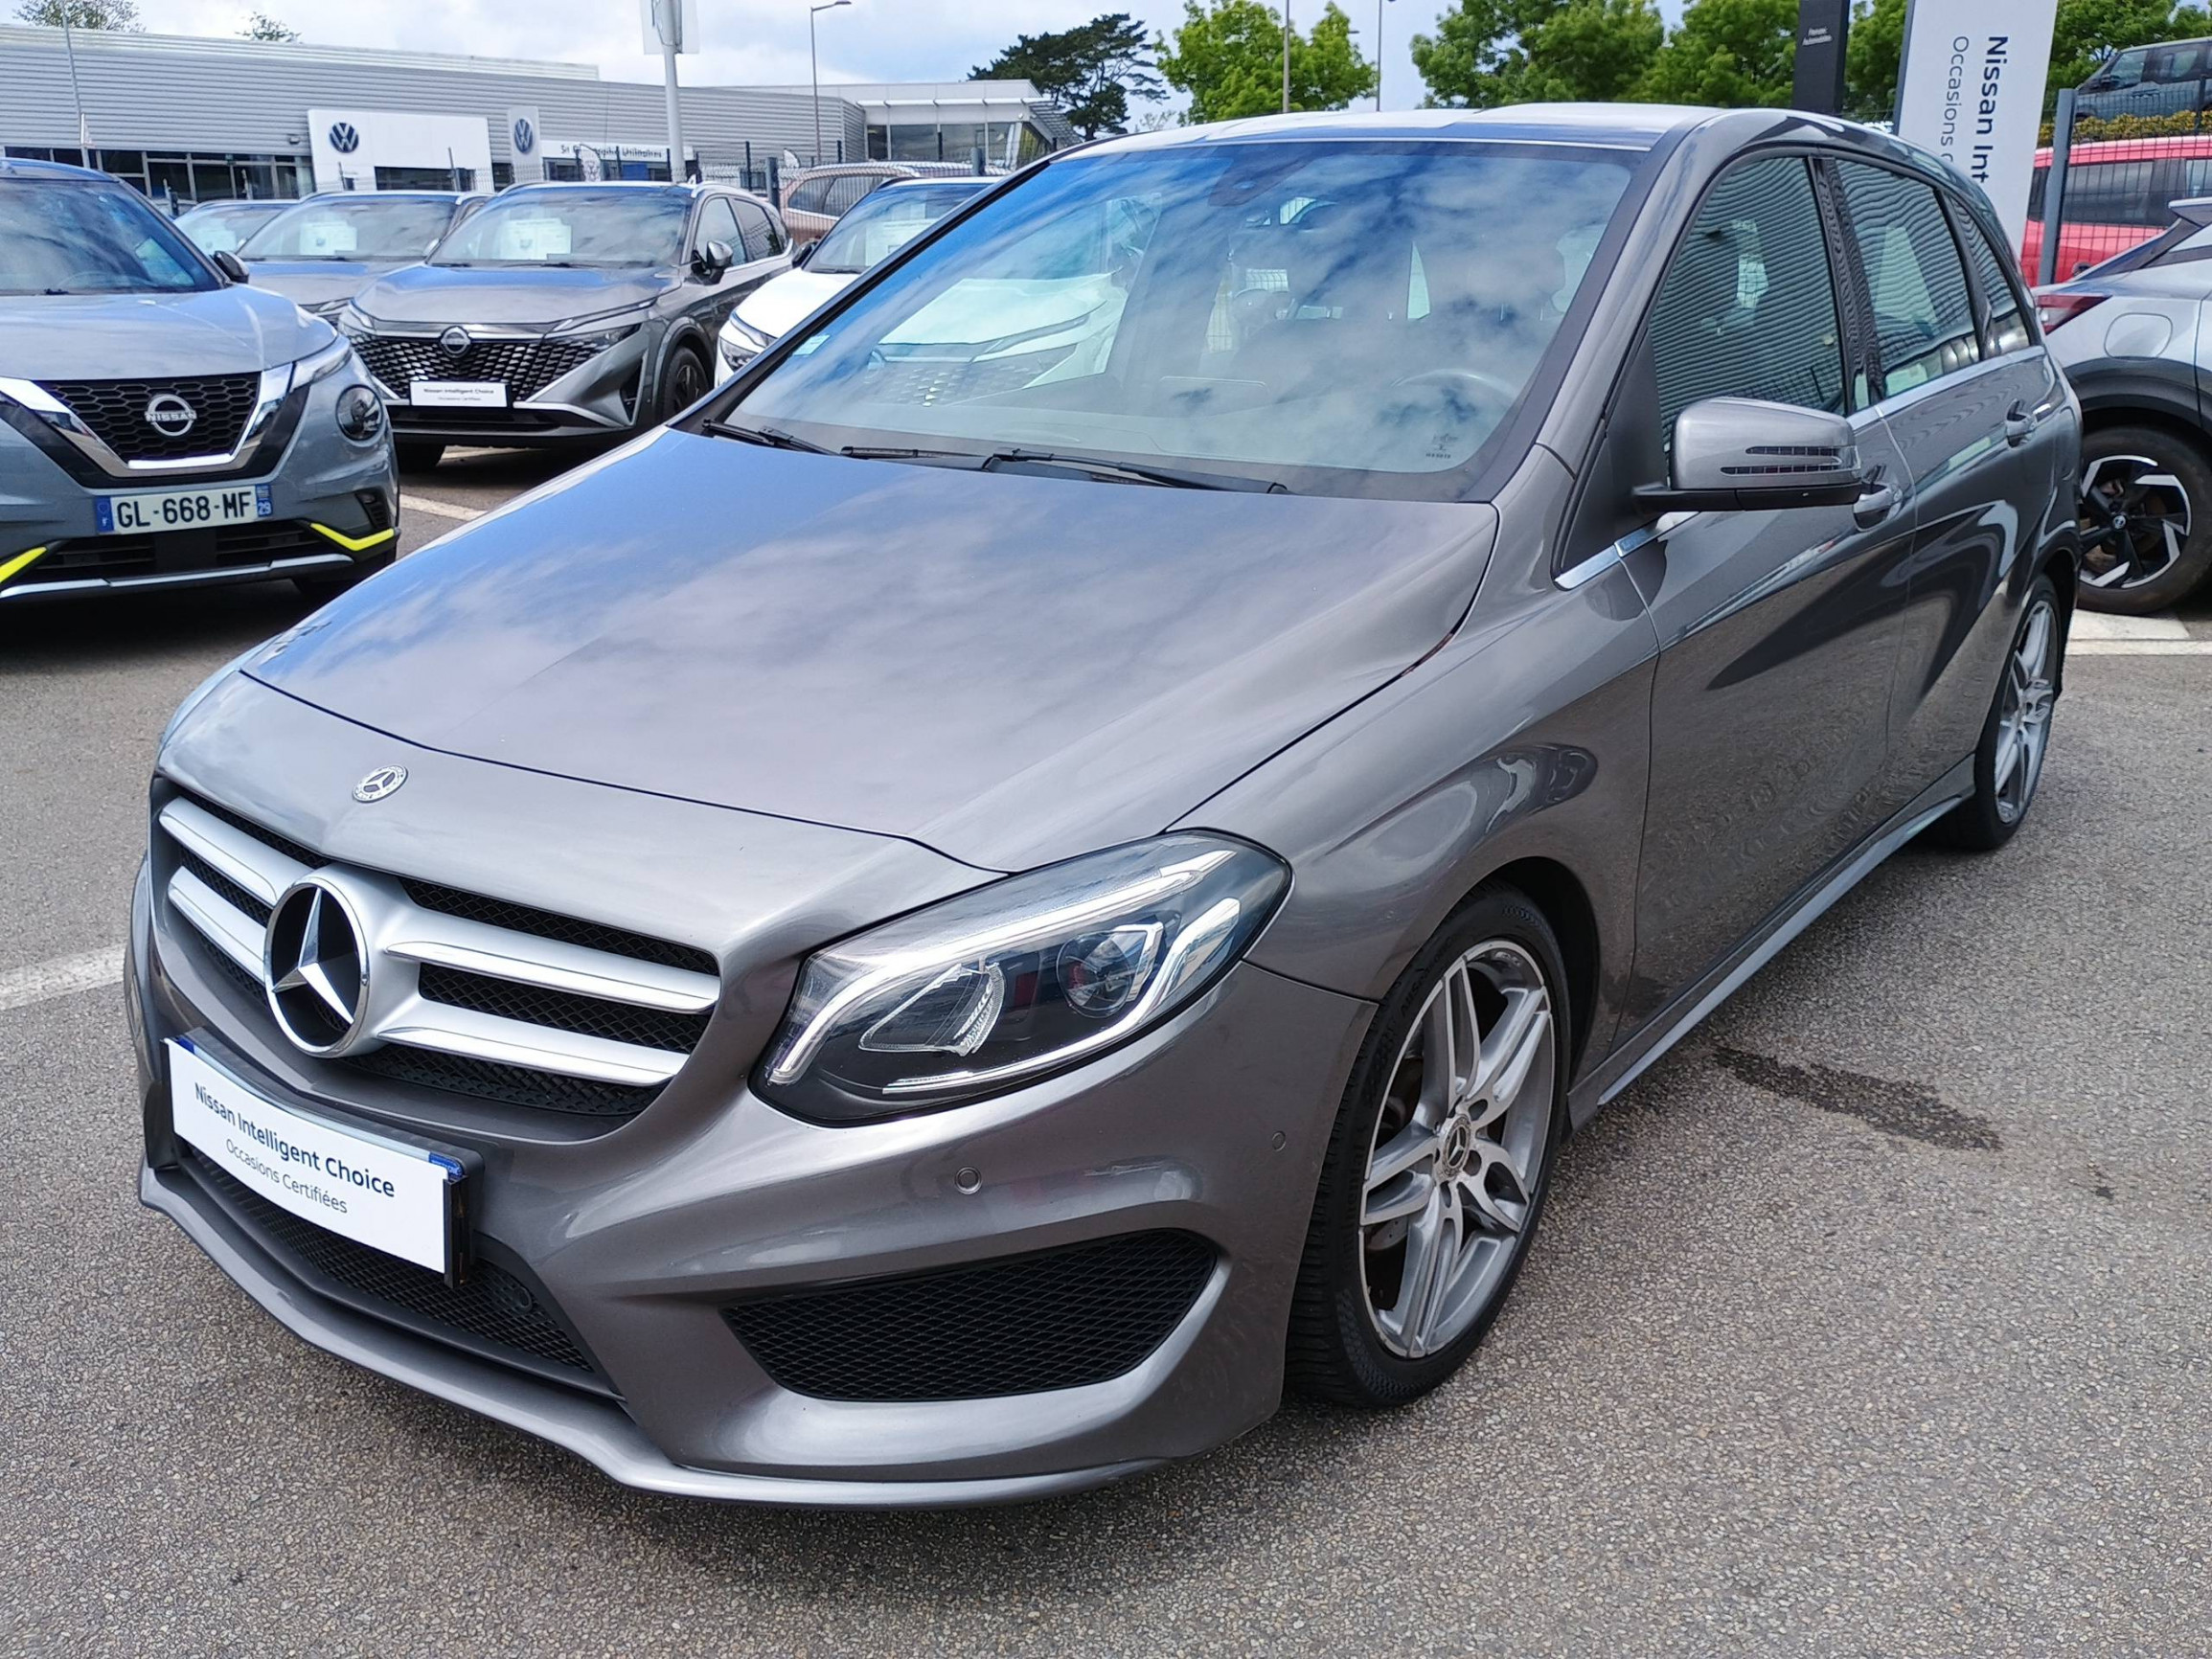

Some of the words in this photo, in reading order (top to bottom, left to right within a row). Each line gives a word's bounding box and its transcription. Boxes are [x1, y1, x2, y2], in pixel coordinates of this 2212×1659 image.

[1940, 35, 1970, 147] Occasions
[1975, 36, 2009, 135] Nissan
[145, 410, 197, 422] NISSAN
[116, 490, 252, 529] GL-668-MF
[194, 1081, 237, 1127] Nissan
[238, 1112, 321, 1171] Intelligent
[325, 1157, 395, 1197] Choice
[225, 1138, 281, 1184] Occasions
[282, 1173, 348, 1214] Certifiées
